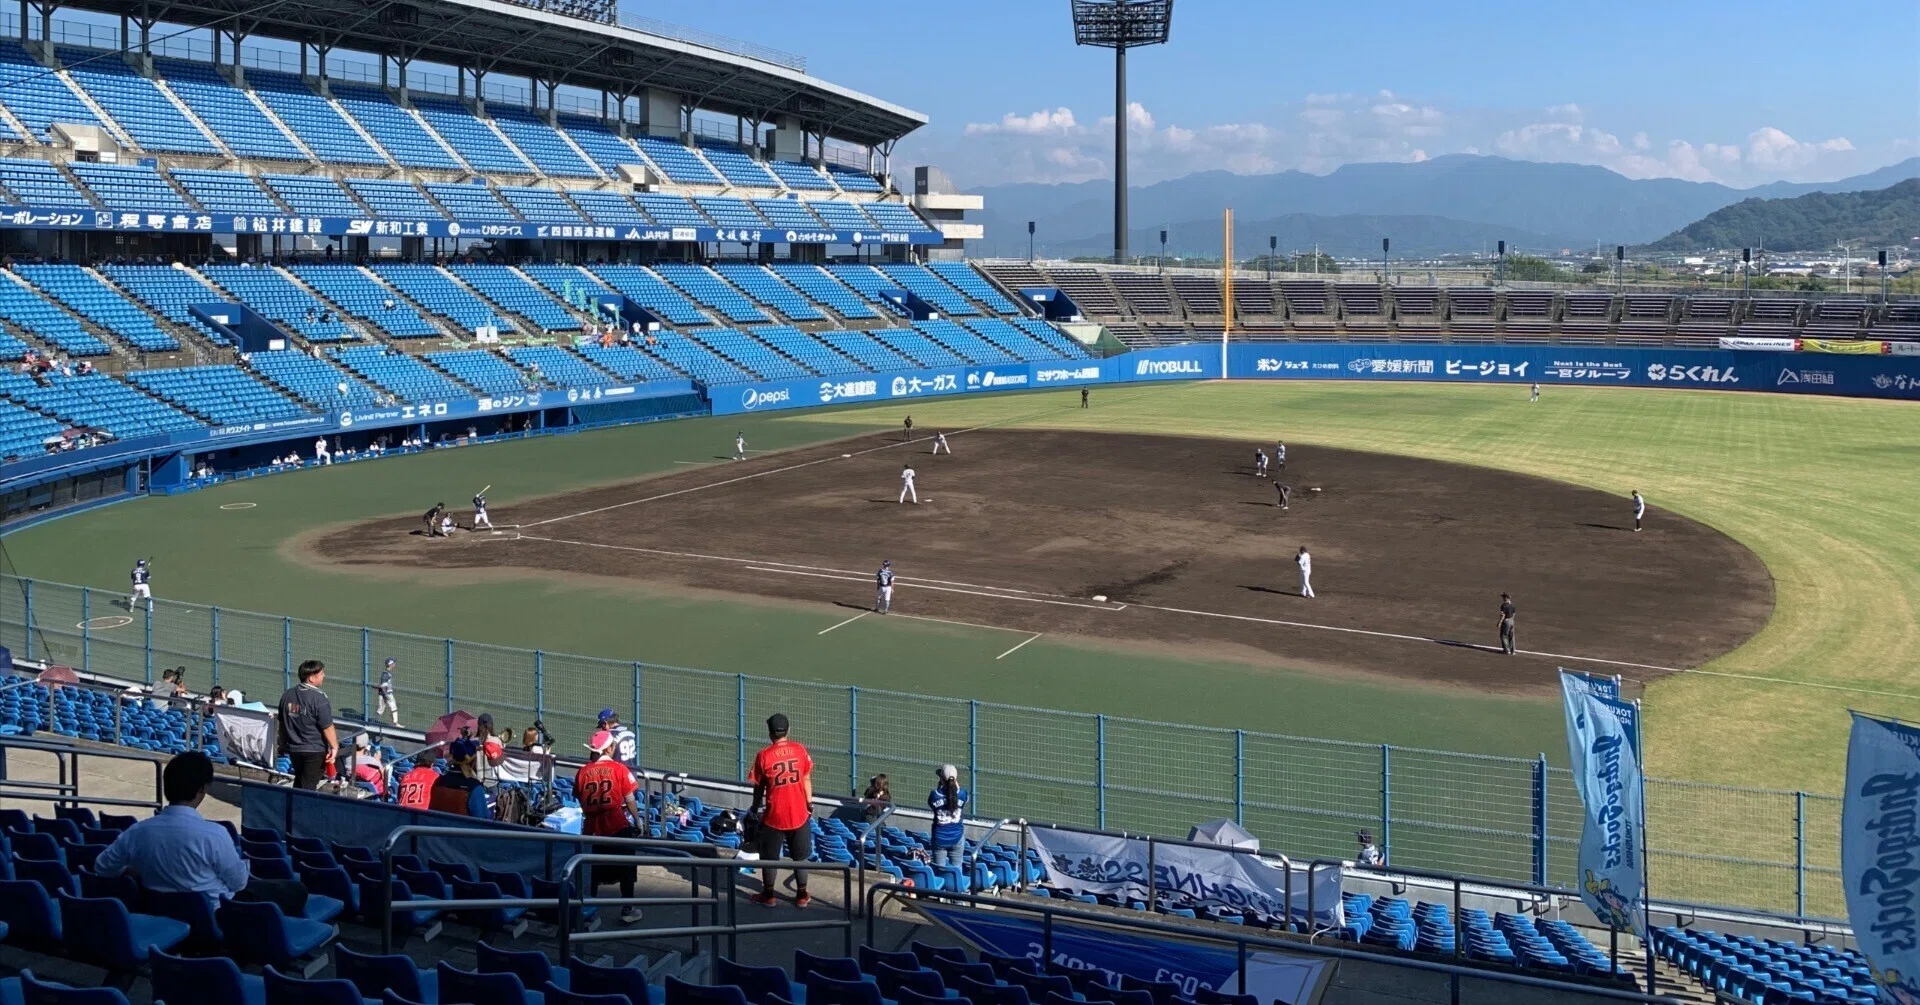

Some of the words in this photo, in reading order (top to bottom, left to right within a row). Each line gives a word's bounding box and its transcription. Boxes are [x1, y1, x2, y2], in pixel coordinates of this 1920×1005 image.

[252, 217, 322, 233] 松井建設
[376, 221, 429, 236] 新和工業
[481, 225, 523, 236] ひめライス
[551, 226, 616, 239] 四国西濃運輸
[716, 229, 762, 241] 愛媛銀行
[1150, 360, 1202, 374] IYOBULL
[1371, 359, 1434, 374] 愛媛新聞
[1445, 359, 1530, 377] ビージョイ
[1669, 365, 1740, 383] らくれん
[833, 380, 877, 398] 大進建設
[908, 374, 958, 393] 大一ガス
[758, 388, 790, 405] pepsi
[401, 402, 448, 419] エネロ
[619, 738, 637, 761] 92
[772, 759, 800, 787] 25
[584, 779, 613, 807] 22
